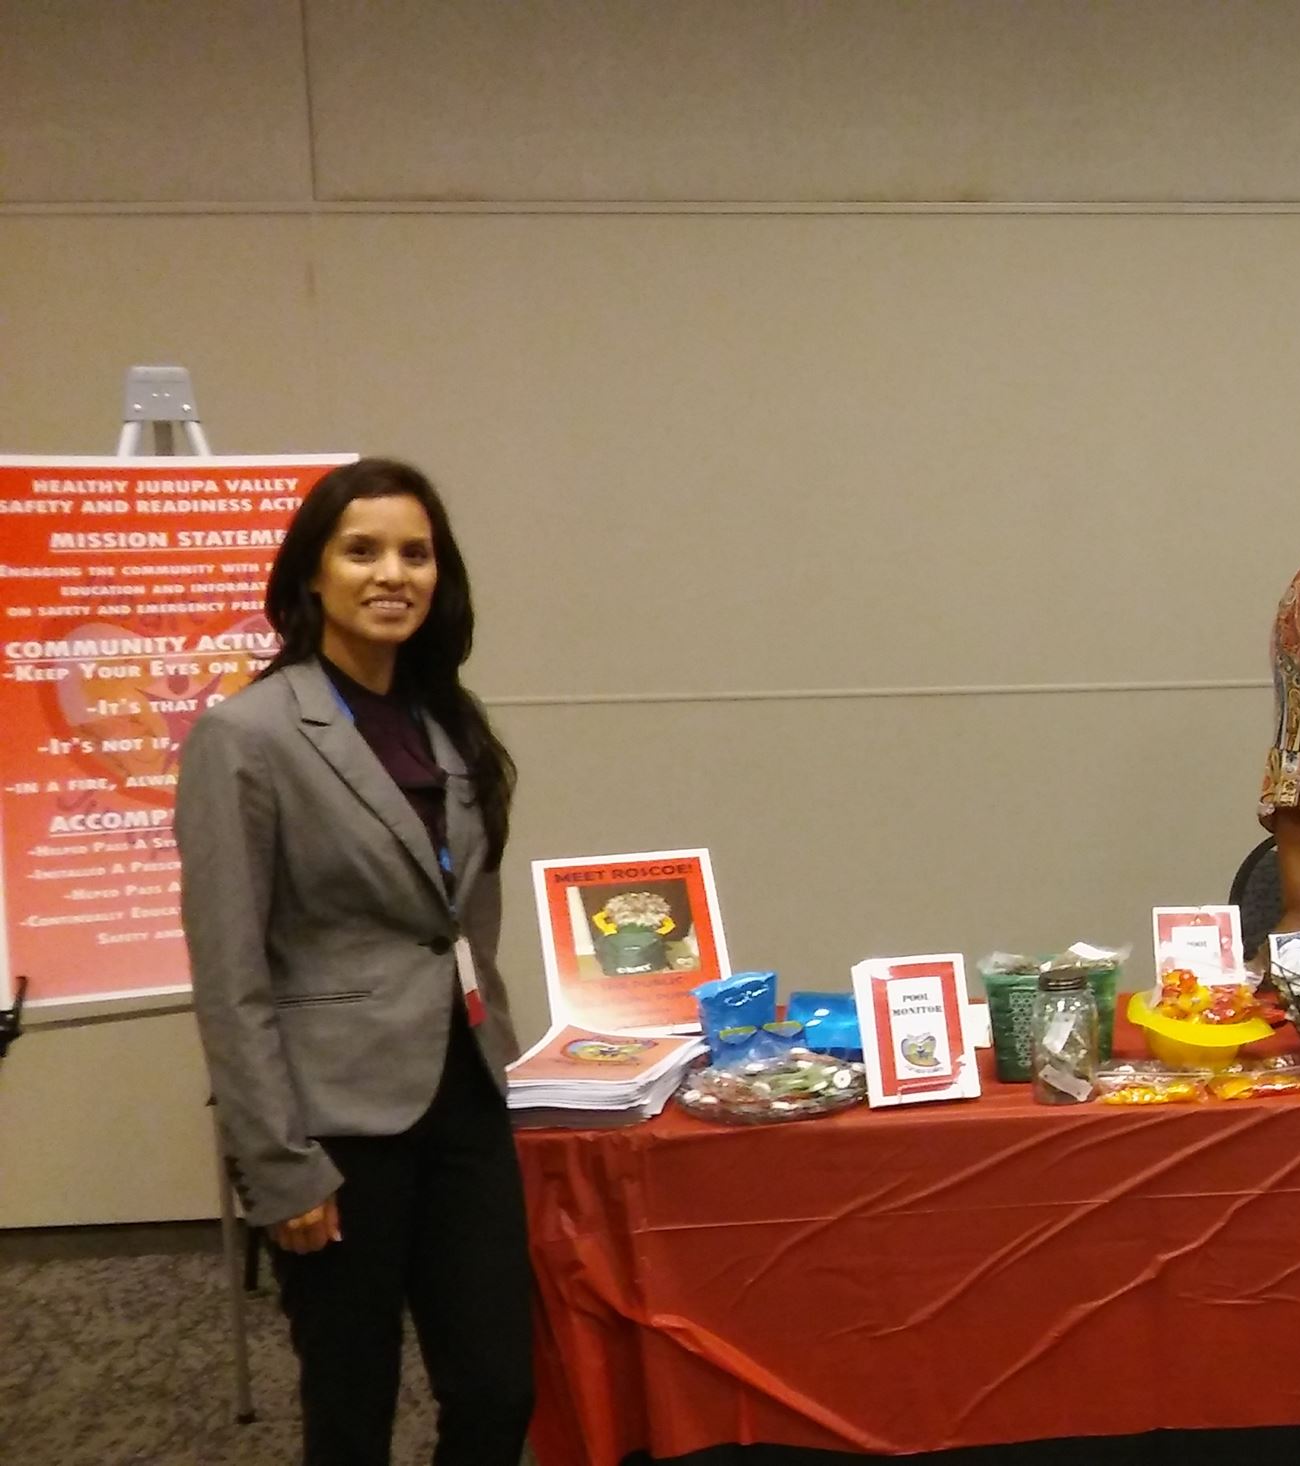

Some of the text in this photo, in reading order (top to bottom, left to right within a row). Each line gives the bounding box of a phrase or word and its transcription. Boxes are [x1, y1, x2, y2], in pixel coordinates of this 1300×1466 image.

[32, 477, 298, 494] HEALTHY JURUPA VALLEY
[0, 499, 73, 514] SAFETY
[81, 499, 129, 513] AND
[135, 498, 253, 513] READINESS
[50, 532, 169, 548] MISSION
[5, 636, 187, 660] COMMUNITY
[554, 869, 605, 884] MEET
